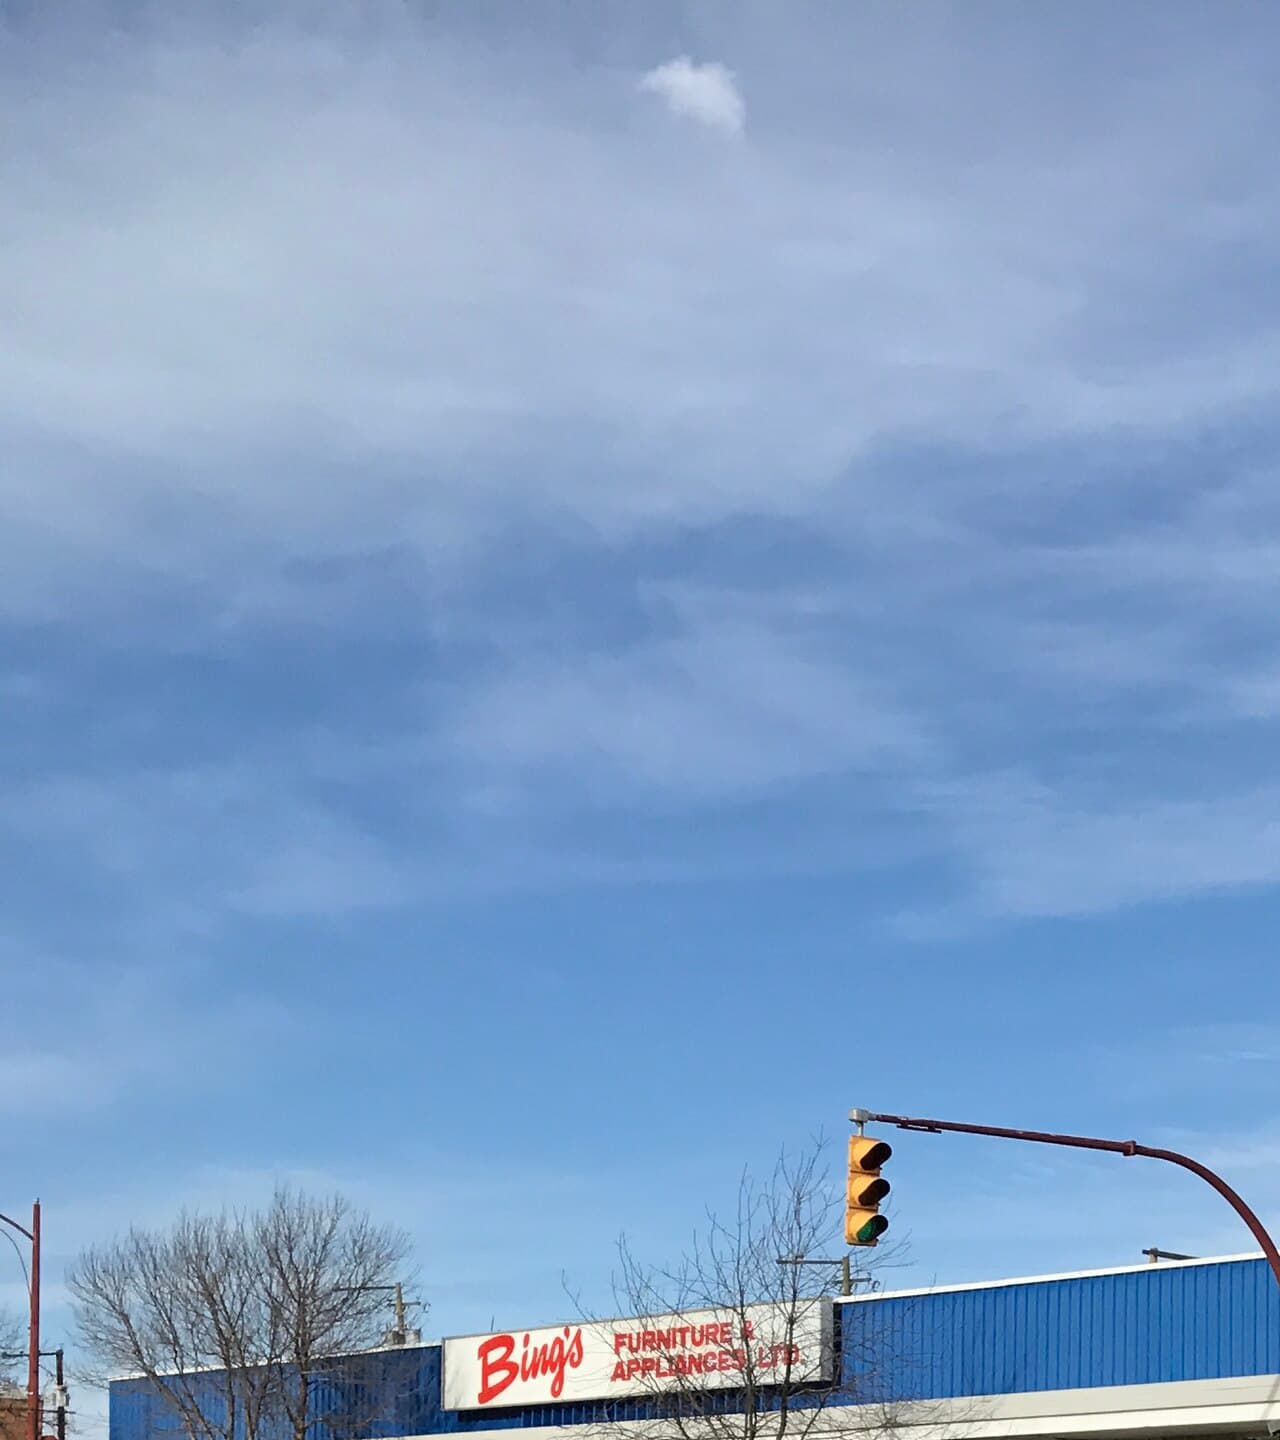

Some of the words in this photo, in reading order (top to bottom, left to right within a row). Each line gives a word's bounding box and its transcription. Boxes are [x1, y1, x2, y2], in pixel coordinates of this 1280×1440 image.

[613, 1322, 732, 1355] FURNITURE
[478, 1326, 584, 1404] Bing's
[610, 1349, 744, 1382] APPLIANCES
